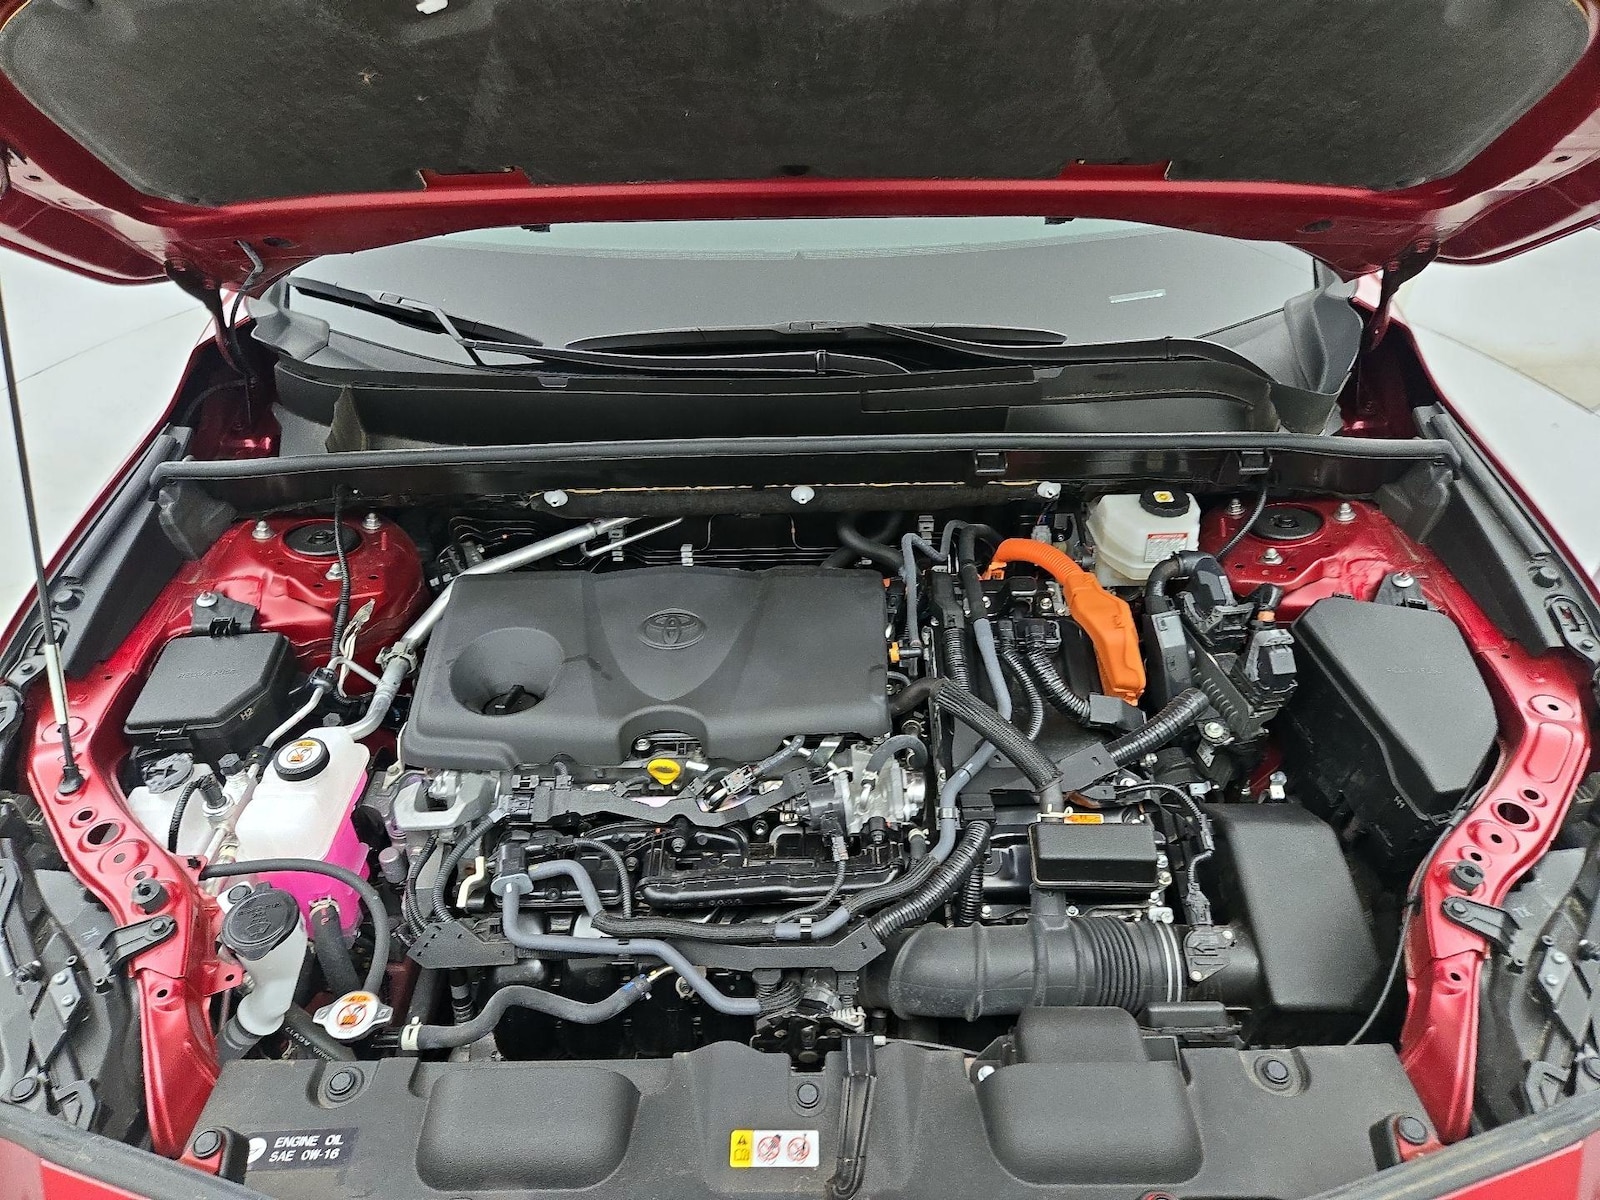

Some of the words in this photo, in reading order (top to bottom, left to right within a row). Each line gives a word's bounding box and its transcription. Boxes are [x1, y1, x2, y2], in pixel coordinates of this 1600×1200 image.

[240, 707, 254, 720] H2
[274, 1135, 321, 1148] ENGINE
[324, 1134, 344, 1146] OIL
[268, 1149, 297, 1162] SAE
[300, 1148, 341, 1161] 0W-16
